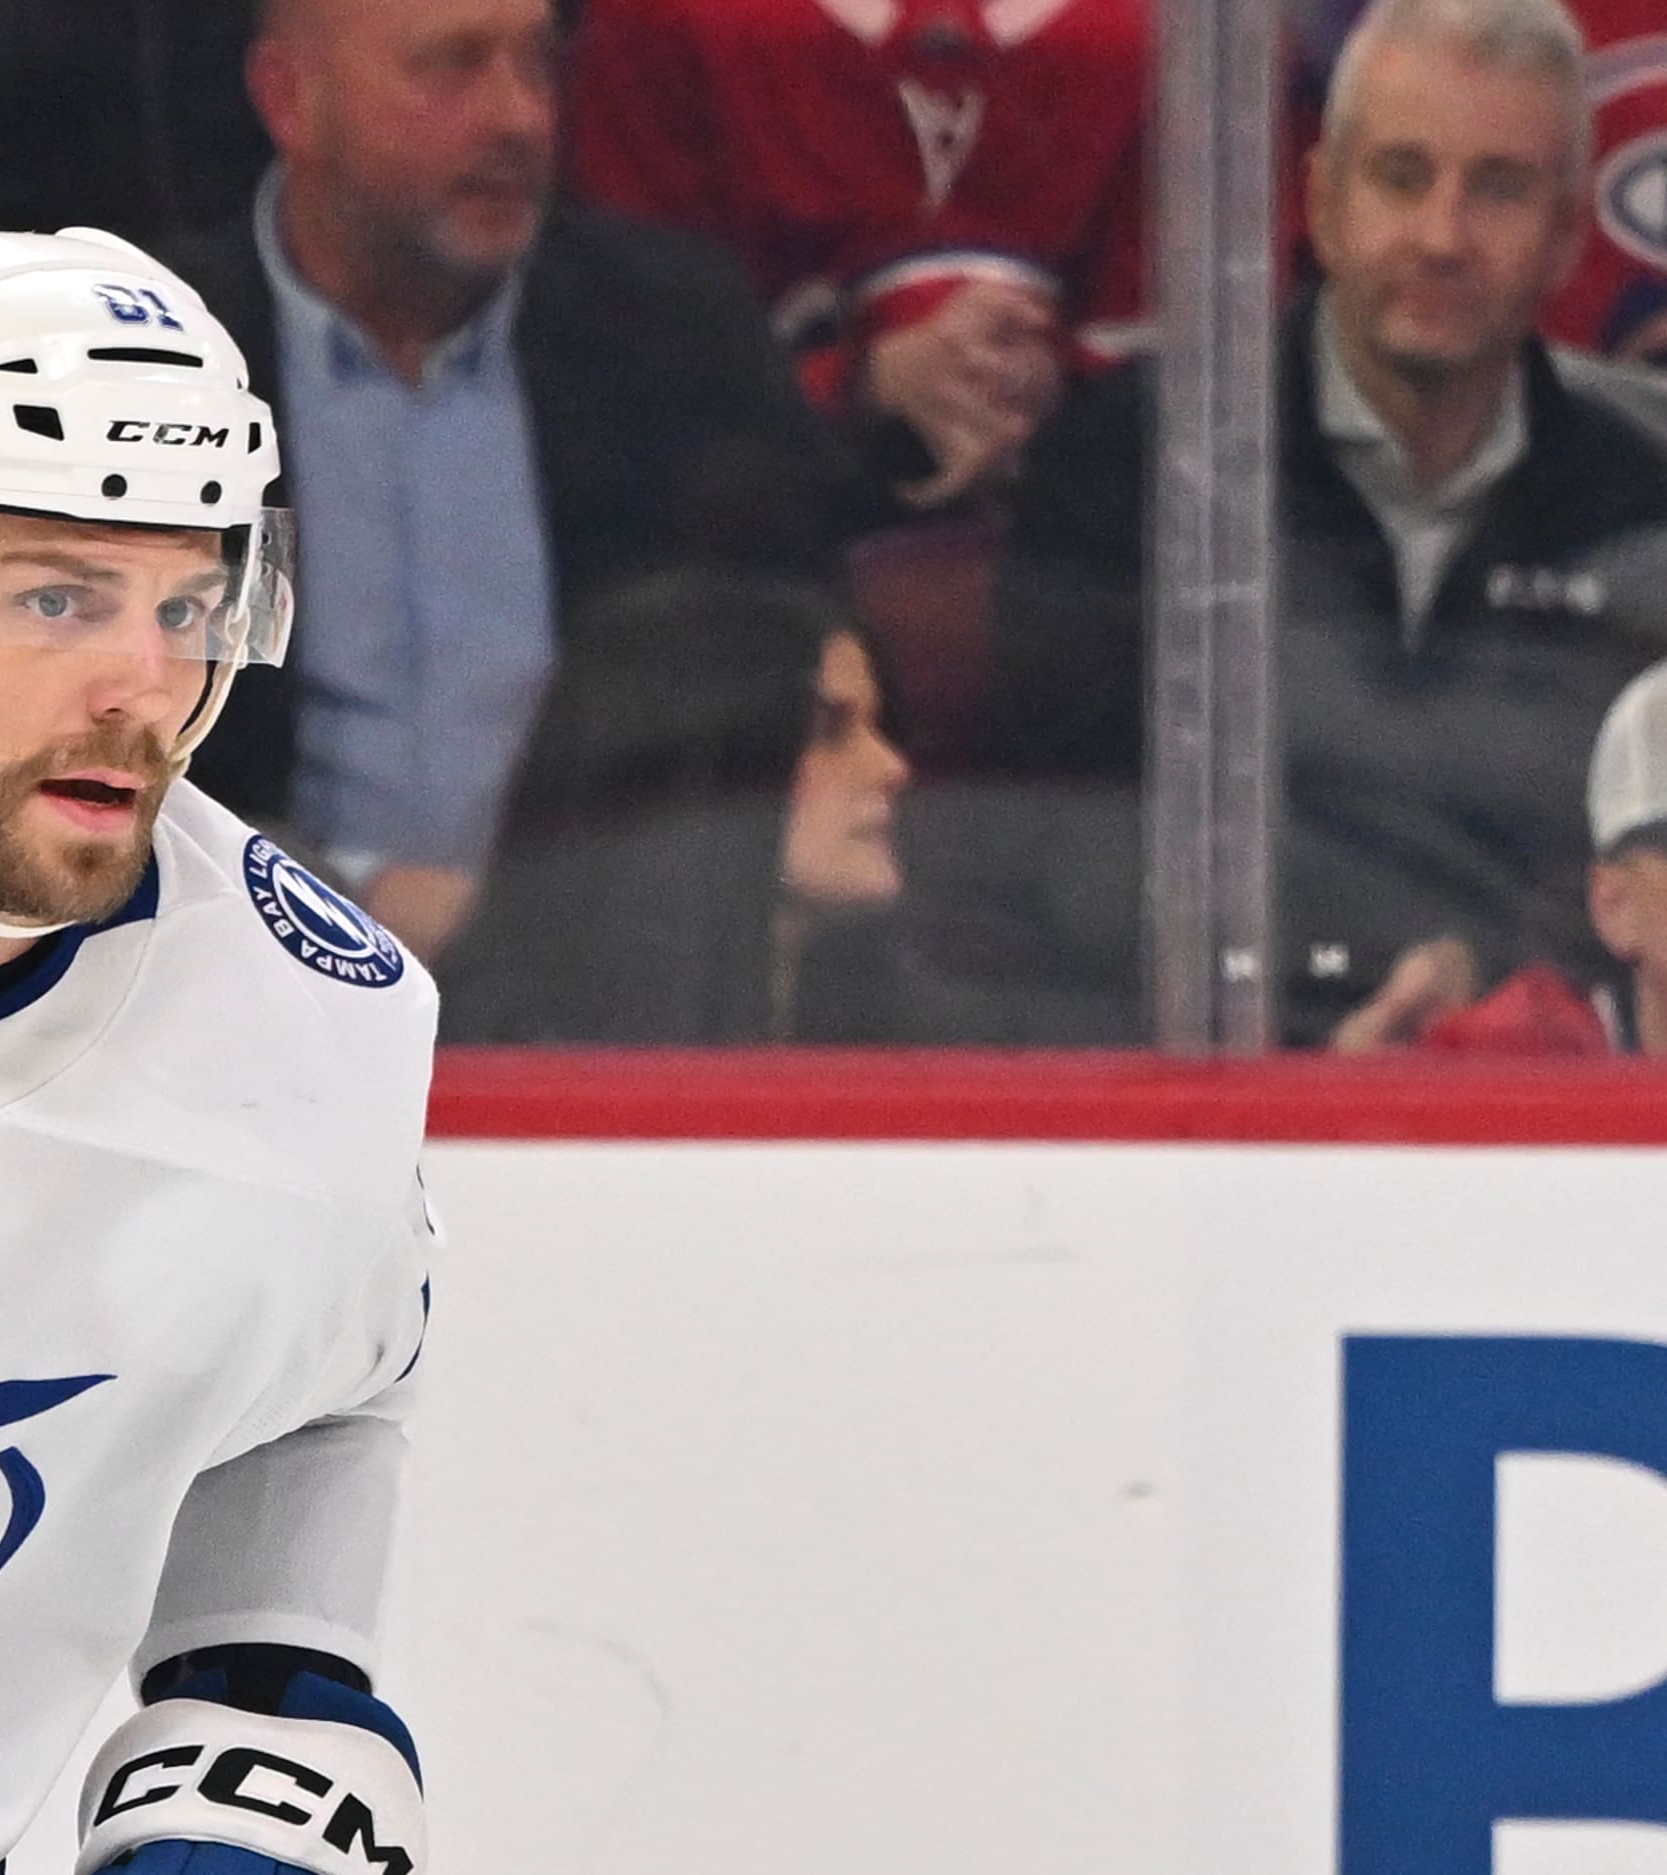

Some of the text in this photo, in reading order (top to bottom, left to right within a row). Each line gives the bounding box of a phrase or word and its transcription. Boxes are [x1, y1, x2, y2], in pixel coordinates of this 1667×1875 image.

[106, 420, 230, 448] CCM
[252, 886, 295, 938] BAY
[300, 939, 388, 982] TAMPA
